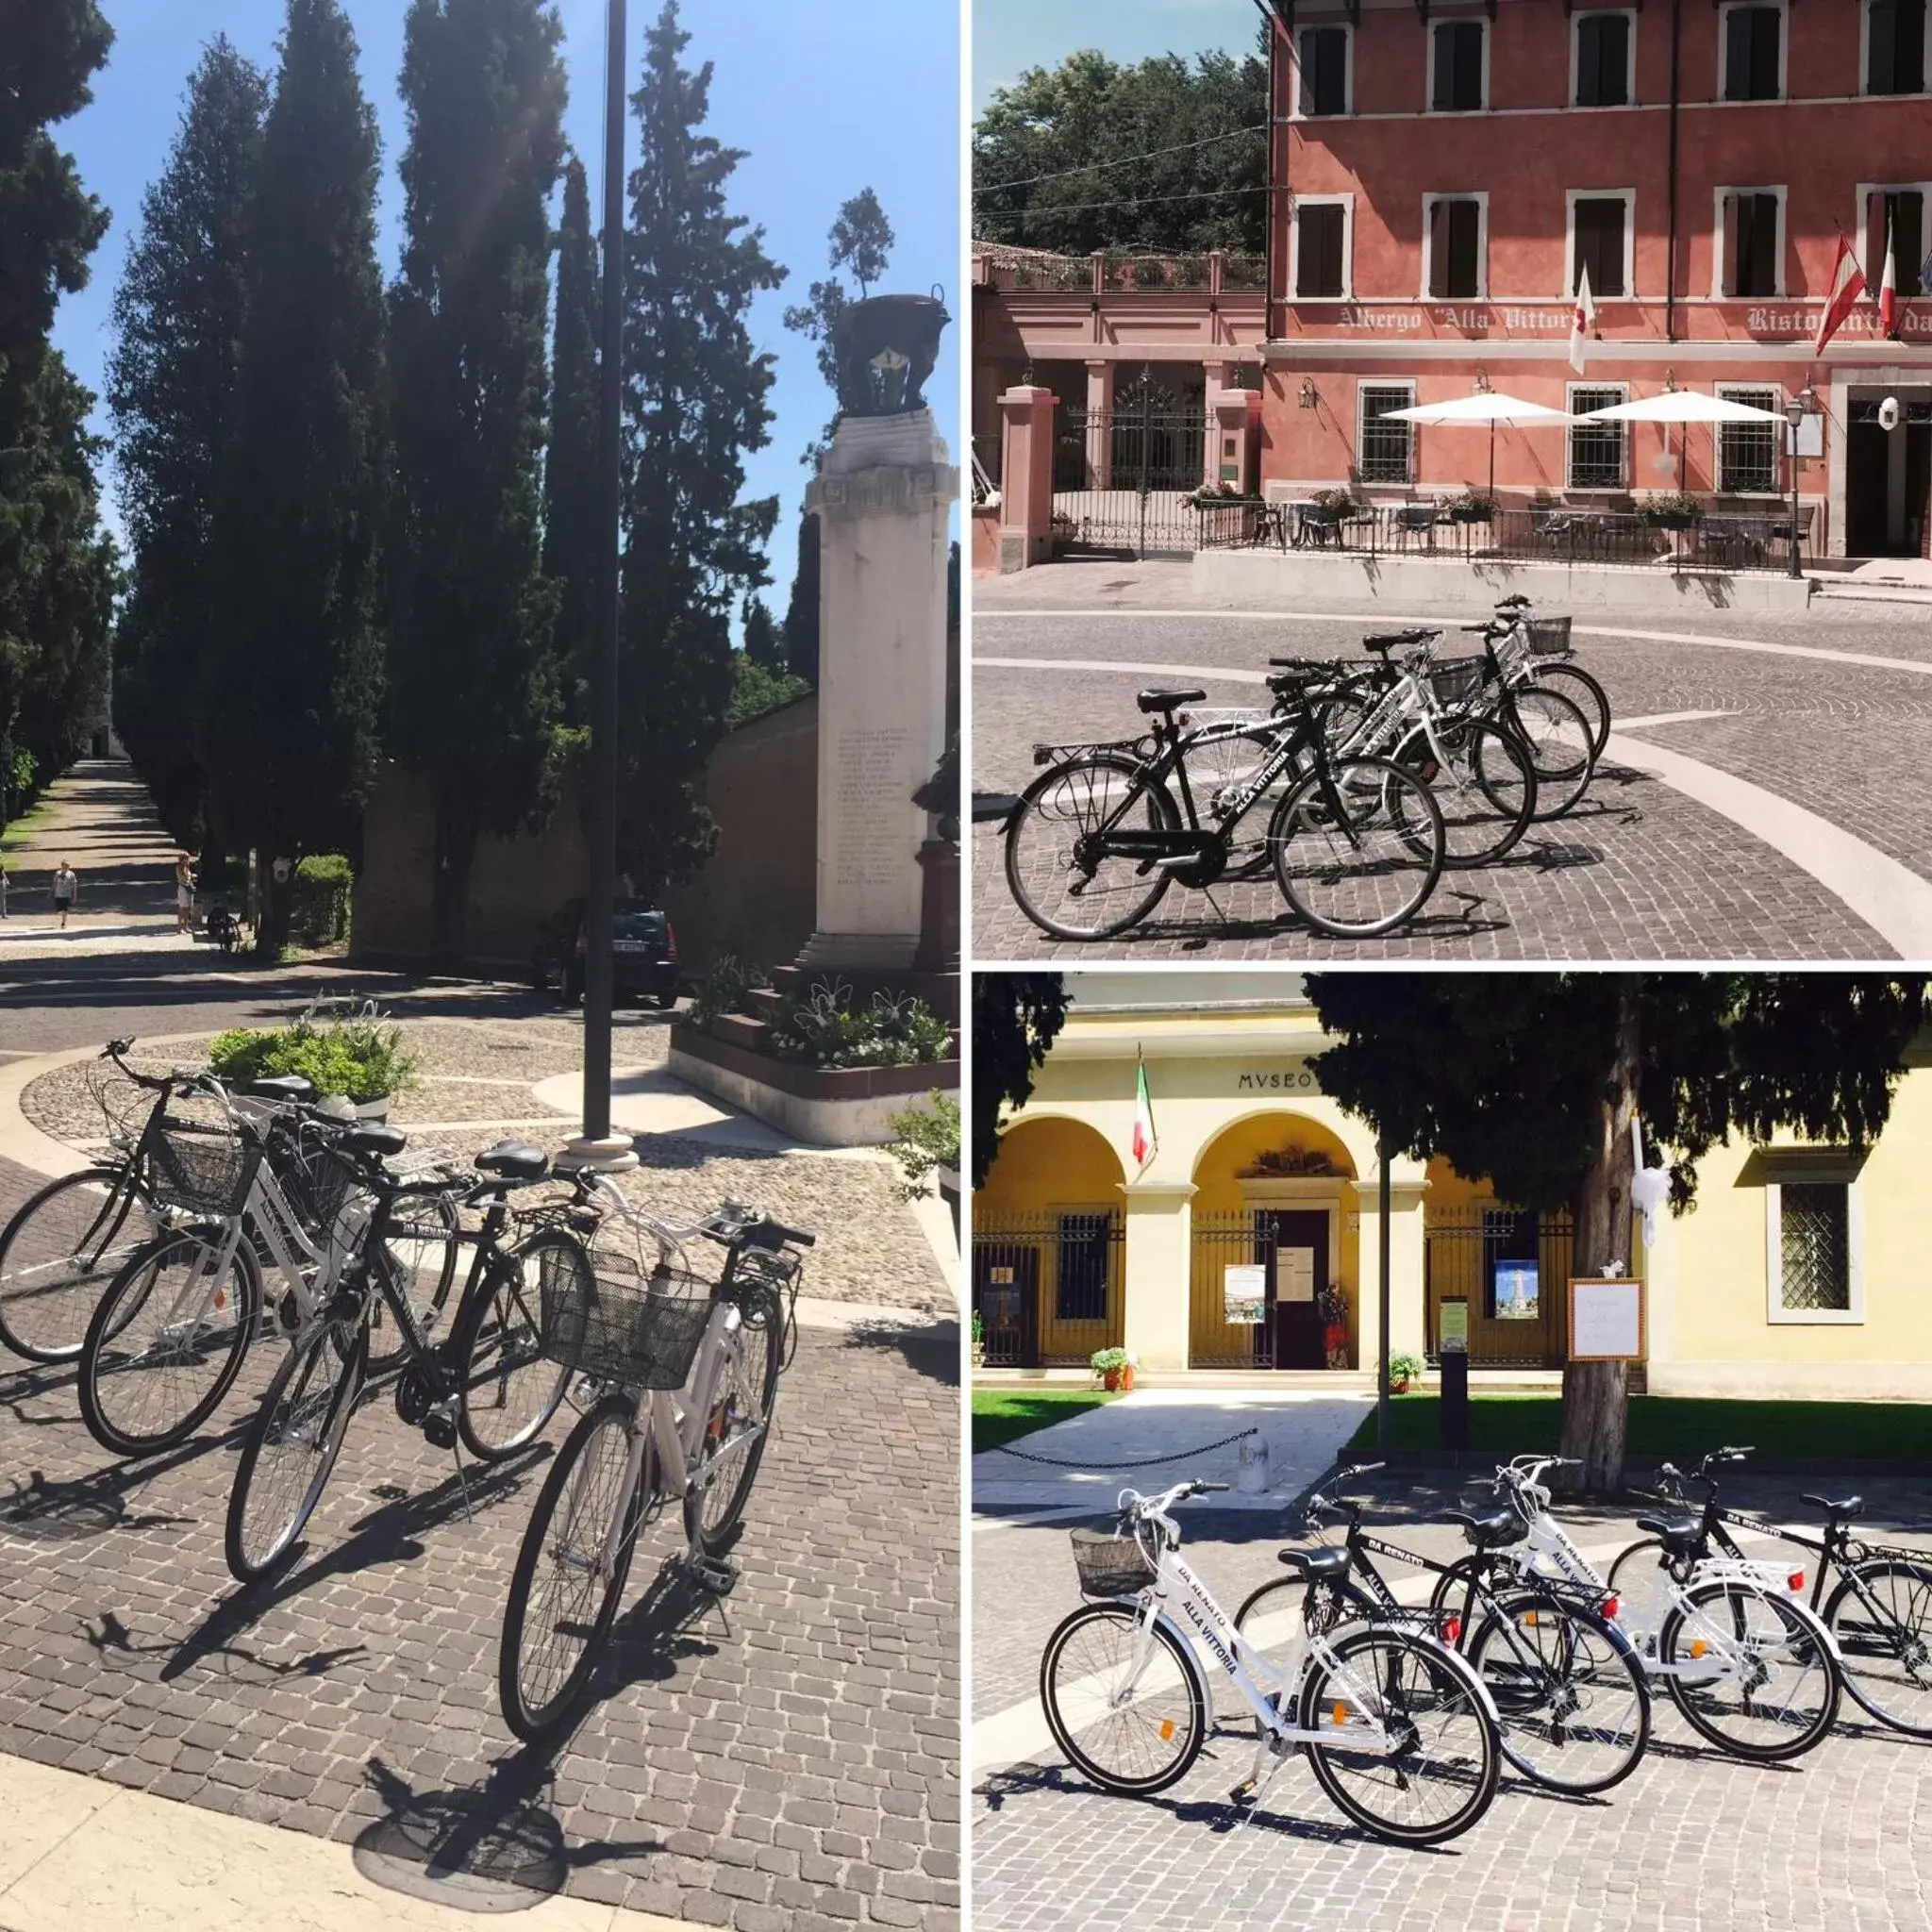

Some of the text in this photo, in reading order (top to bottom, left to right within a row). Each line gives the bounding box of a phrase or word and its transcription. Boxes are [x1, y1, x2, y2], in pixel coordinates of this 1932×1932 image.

[1338, 308, 1423, 331] Albergo
[1374, 709, 1404, 742] VITTORIA
[1236, 751, 1290, 814] ALLA VITTORIA
[418, 1224, 454, 1239] RENATO
[1725, 1513, 1782, 1539] DA RENATO
[1368, 1539, 1425, 1568] DA RENATO
[1552, 1552, 1572, 1574] ALLA
[1177, 1567, 1226, 1626] DA RENATO
[1365, 1573, 1386, 1599] ALLA
[1181, 1600, 1239, 1676] ALLA VITTORIA
